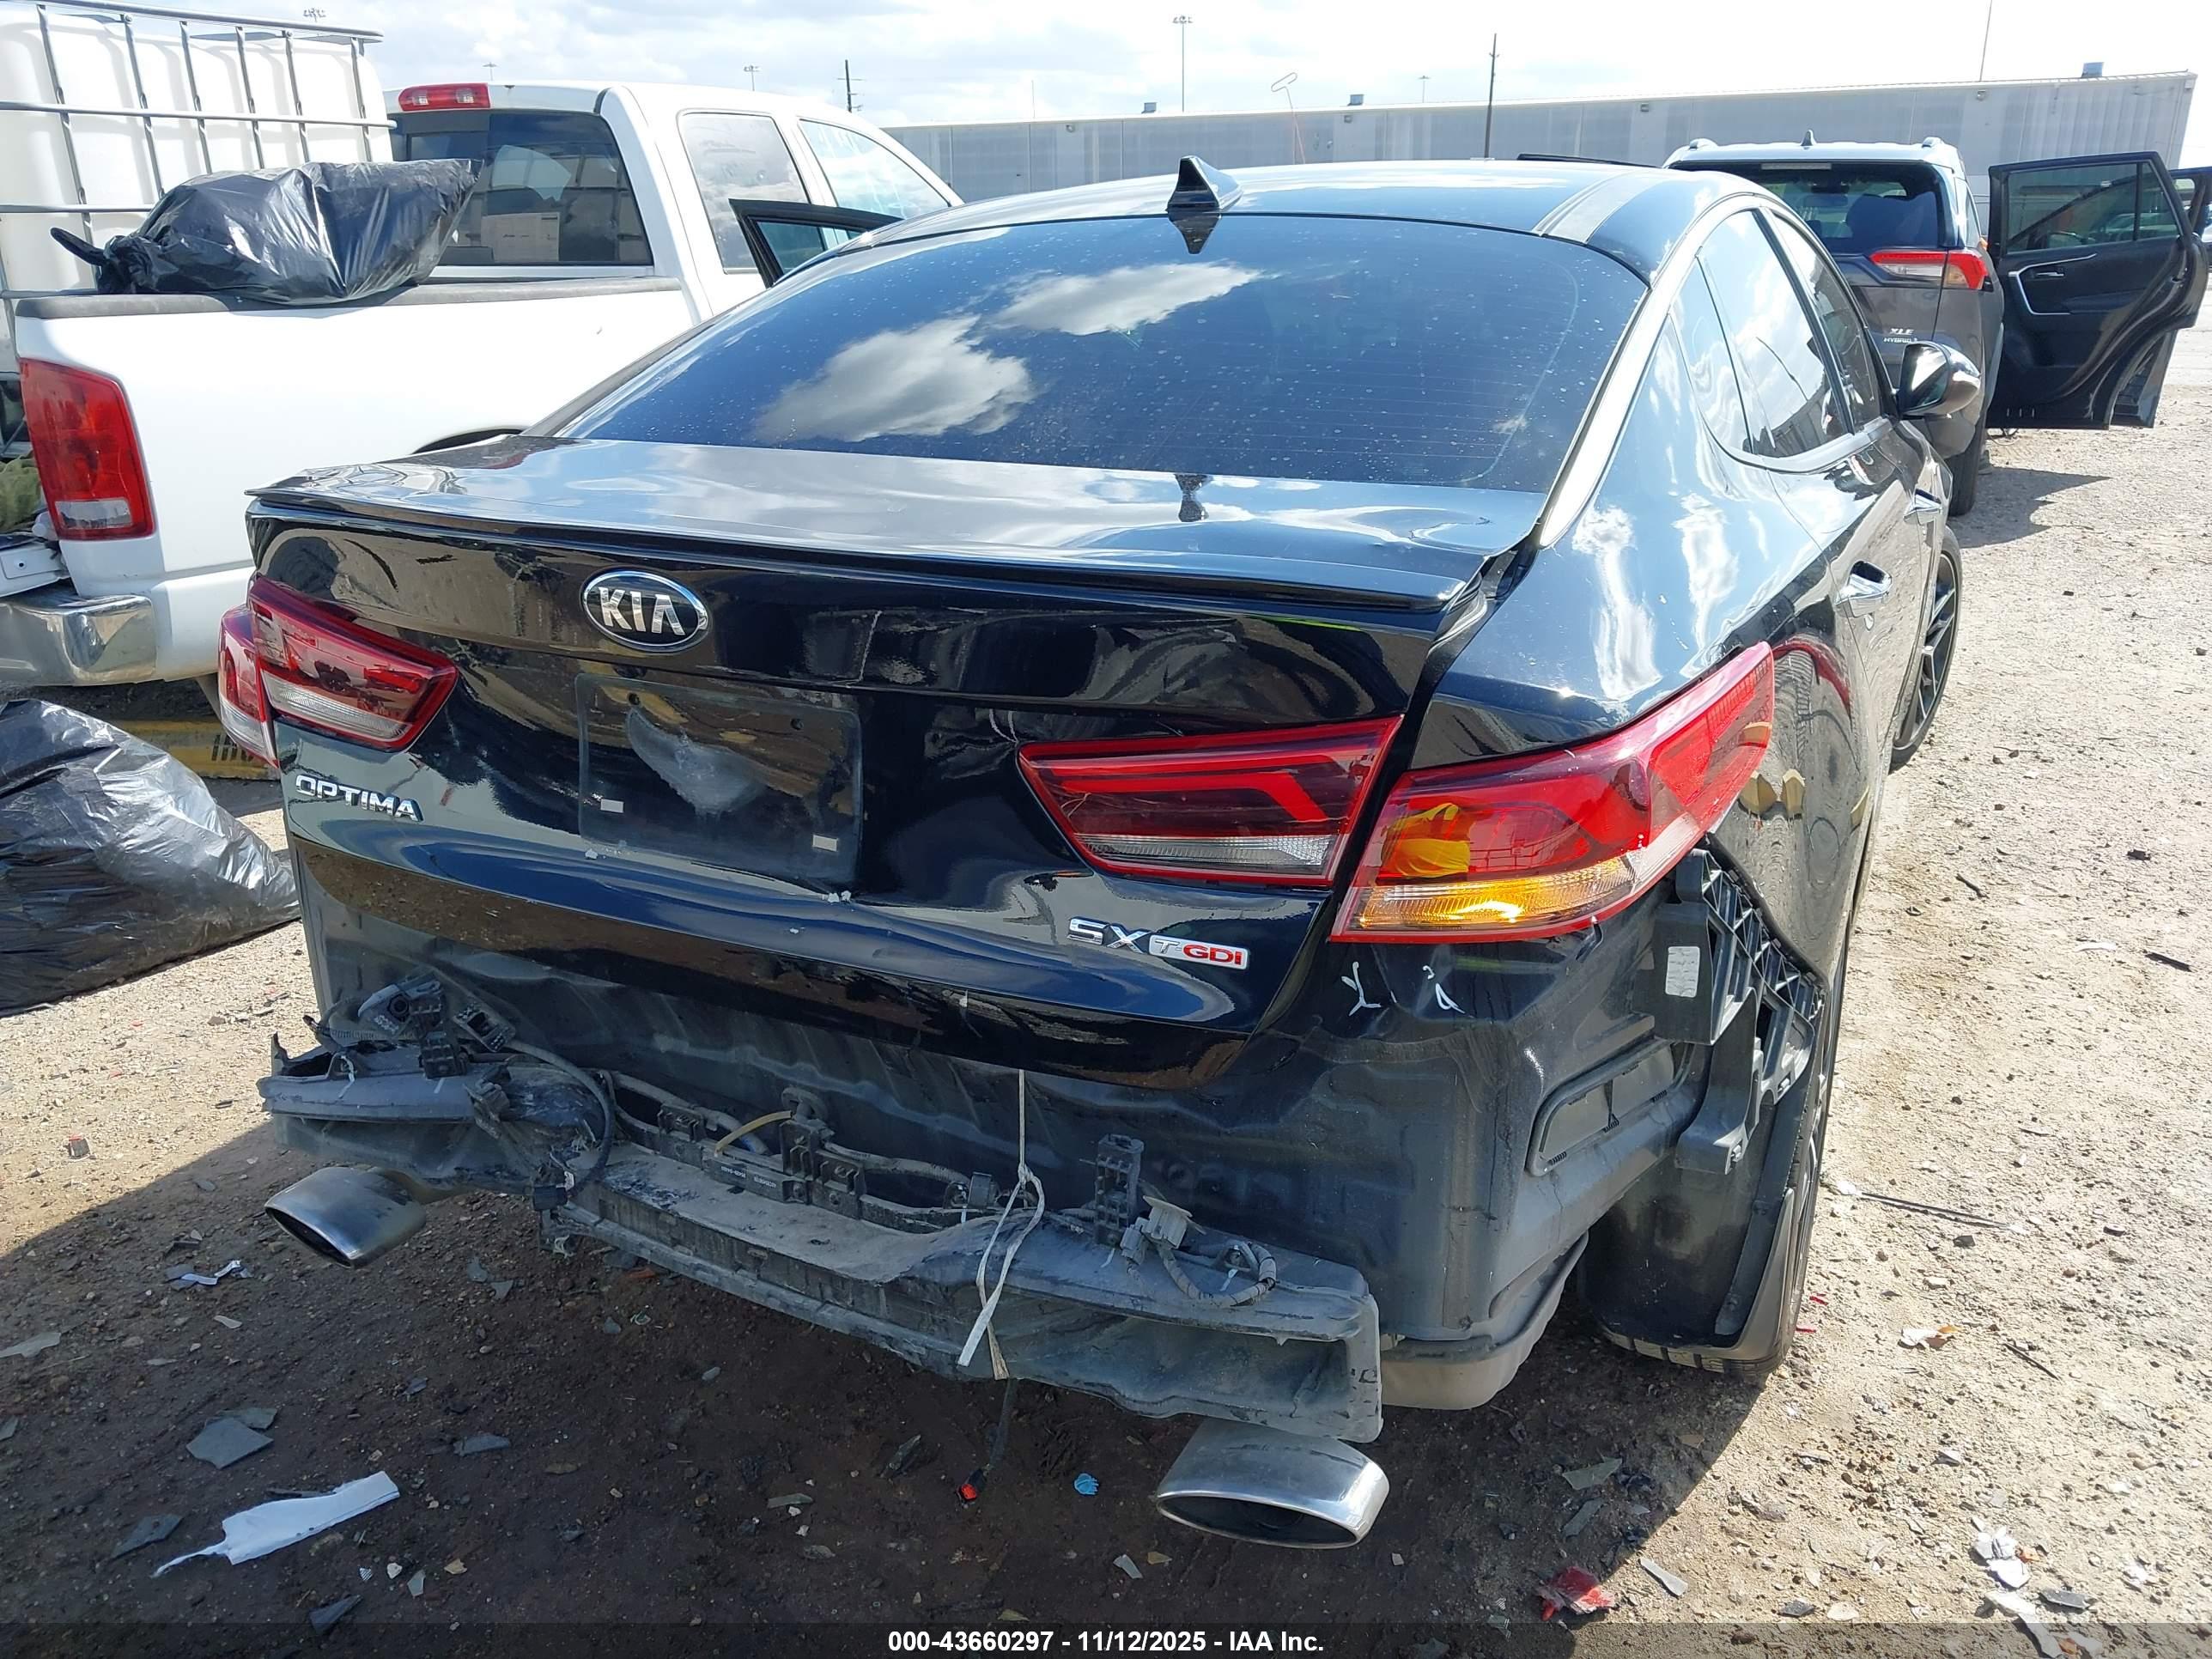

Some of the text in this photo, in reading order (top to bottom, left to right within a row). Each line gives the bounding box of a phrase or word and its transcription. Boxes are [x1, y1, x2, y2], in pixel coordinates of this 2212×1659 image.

[1890, 327, 1915, 336] XLE
[598, 586, 686, 635] KIA
[295, 775, 424, 823] OPTIMA
[1066, 916, 1152, 955] SX
